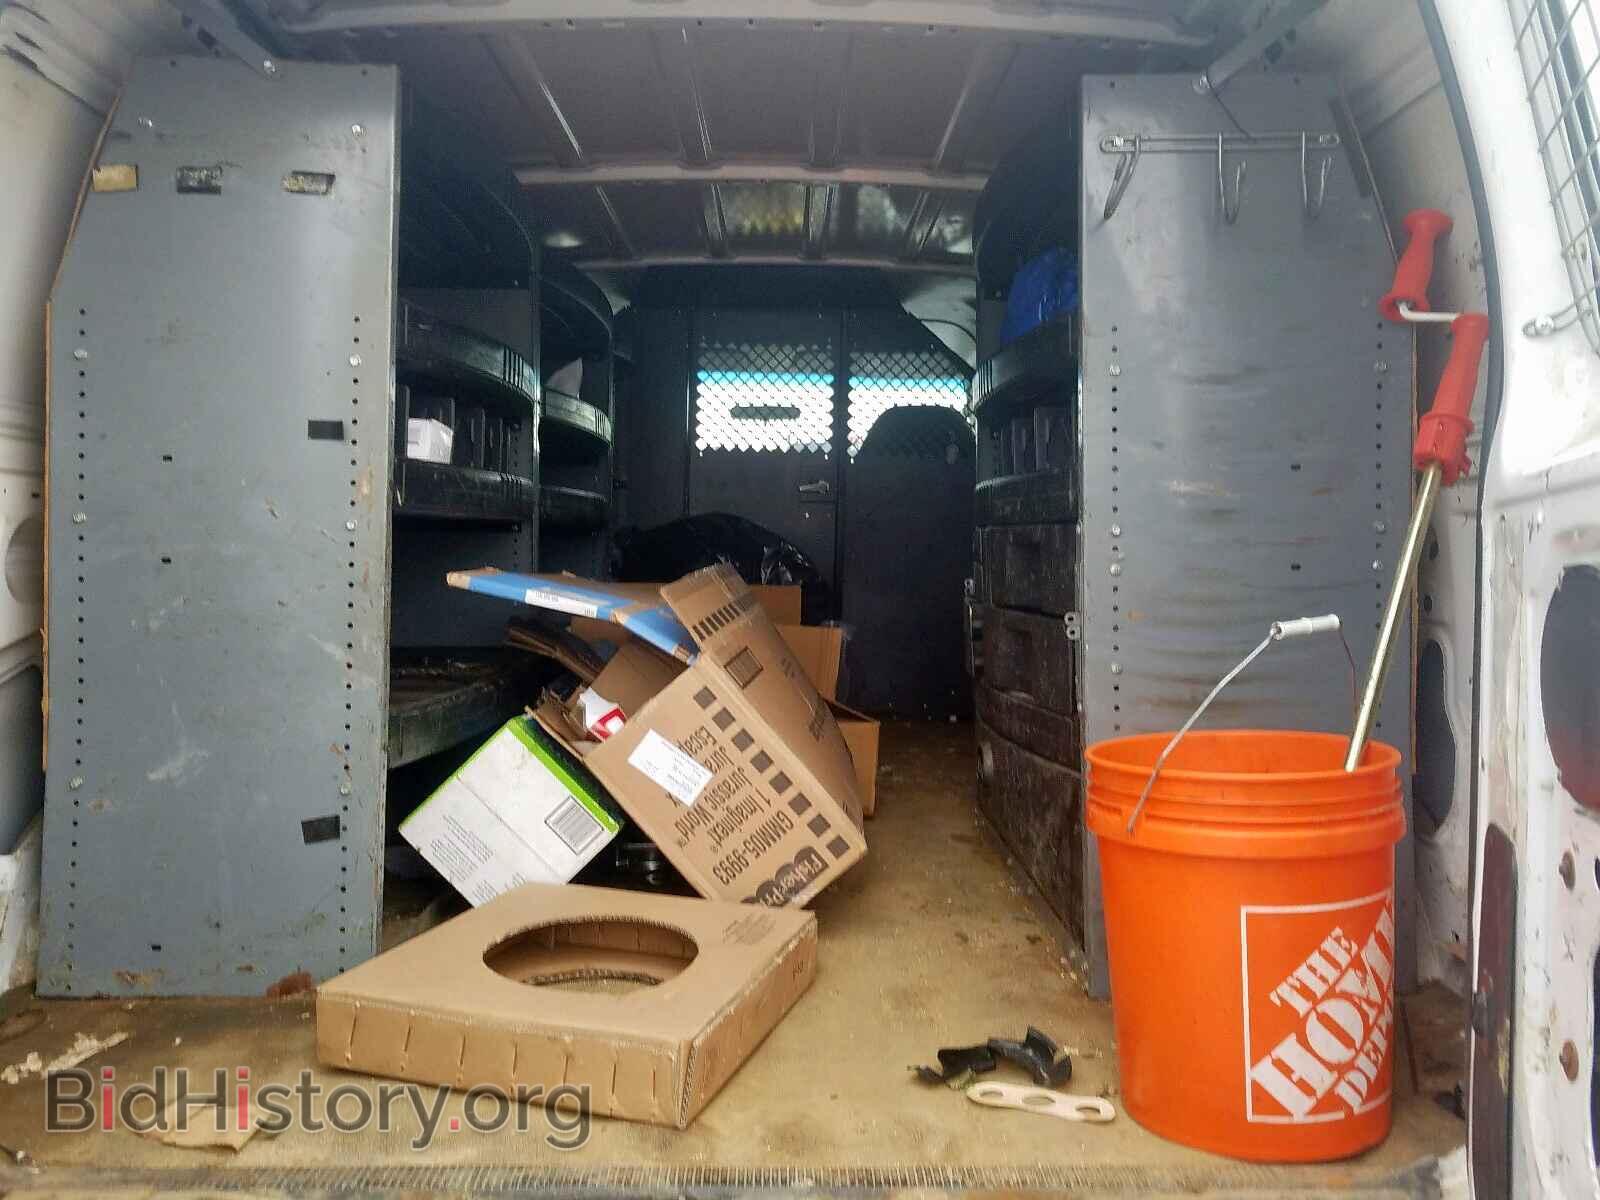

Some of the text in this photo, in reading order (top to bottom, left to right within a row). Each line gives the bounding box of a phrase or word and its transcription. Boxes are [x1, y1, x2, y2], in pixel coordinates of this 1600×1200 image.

[704, 767, 753, 811] Jurassic
[755, 787, 772, 808] 1
[712, 809, 795, 886] GMM05-9993
[1269, 925, 1358, 1018] THE
